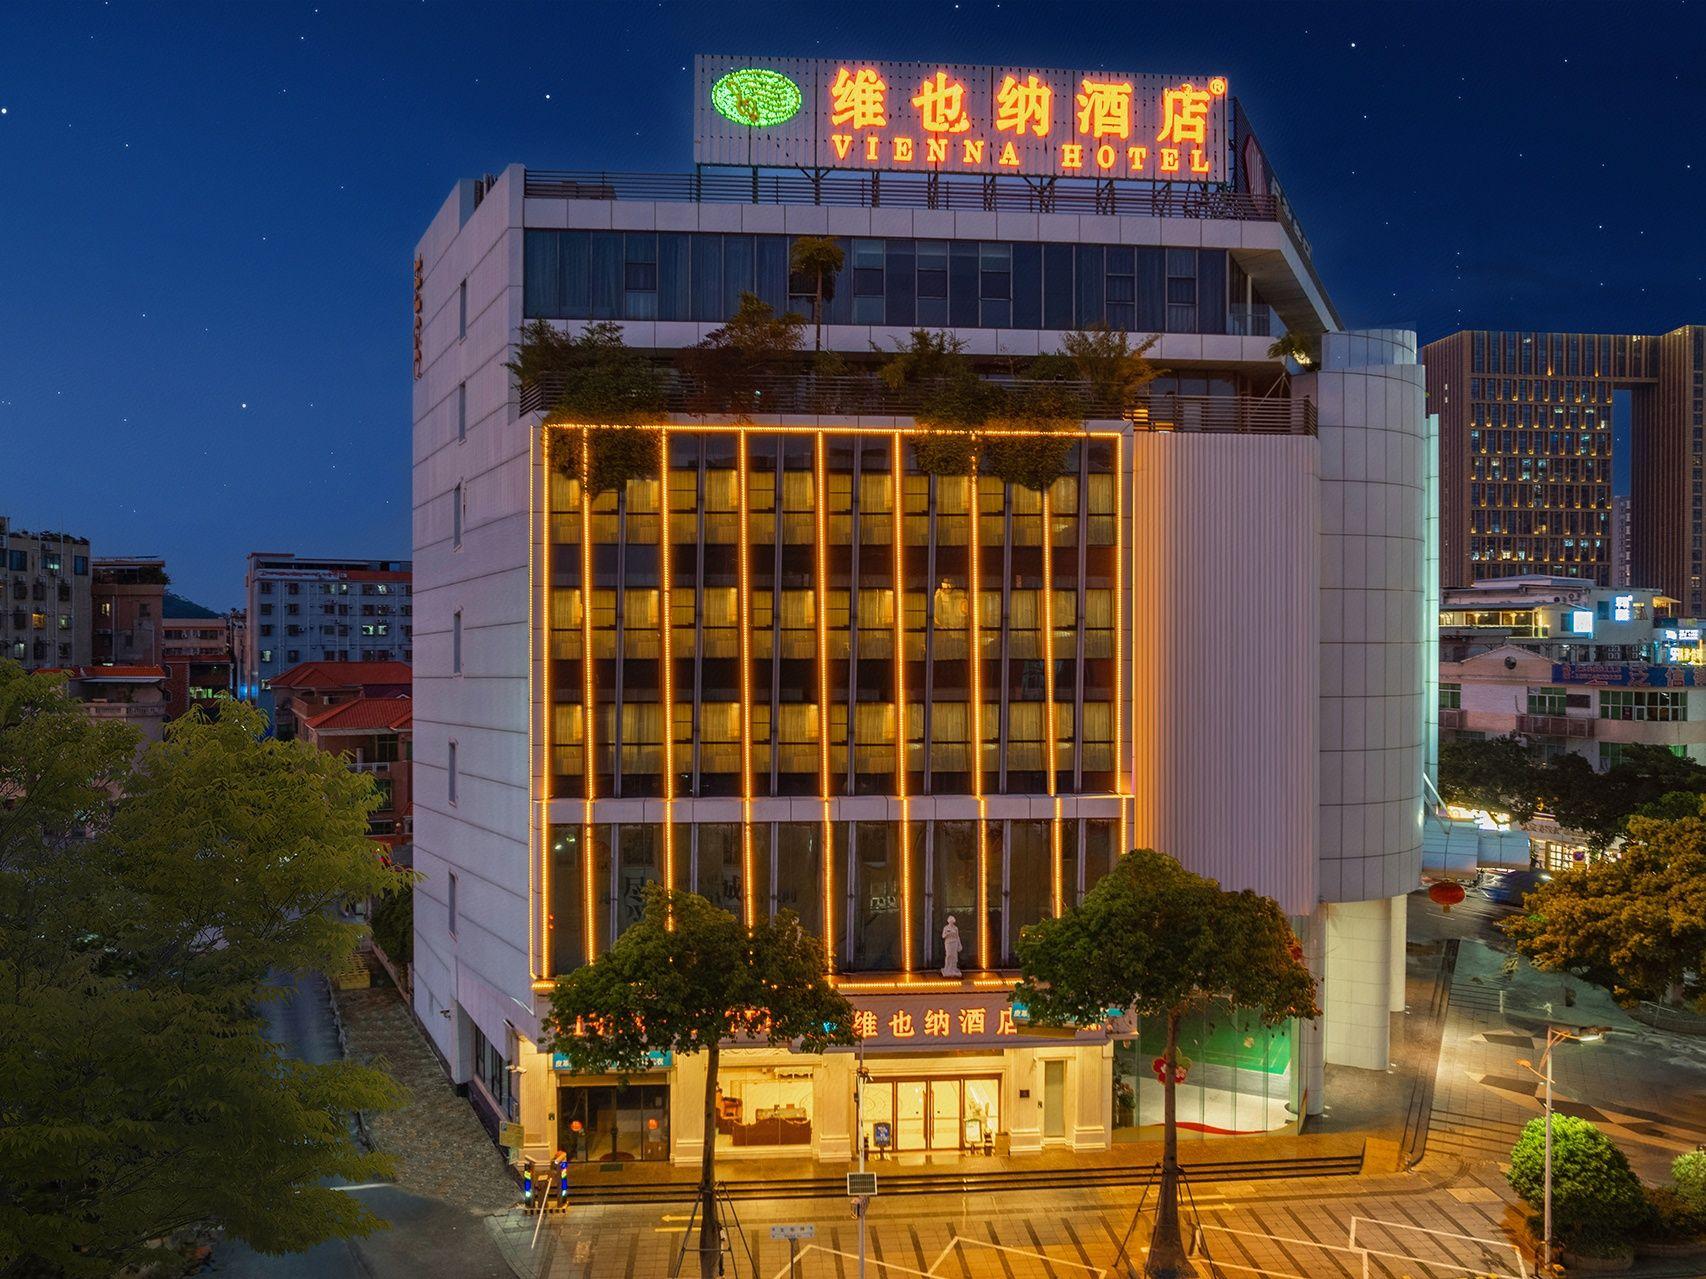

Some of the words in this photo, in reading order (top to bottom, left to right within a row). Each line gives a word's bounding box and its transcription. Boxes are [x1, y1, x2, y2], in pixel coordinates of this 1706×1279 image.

[831, 67, 1211, 143] 维也纳酒店
[831, 134, 1021, 167] VIENNA
[1061, 143, 1210, 174] HOTEL
